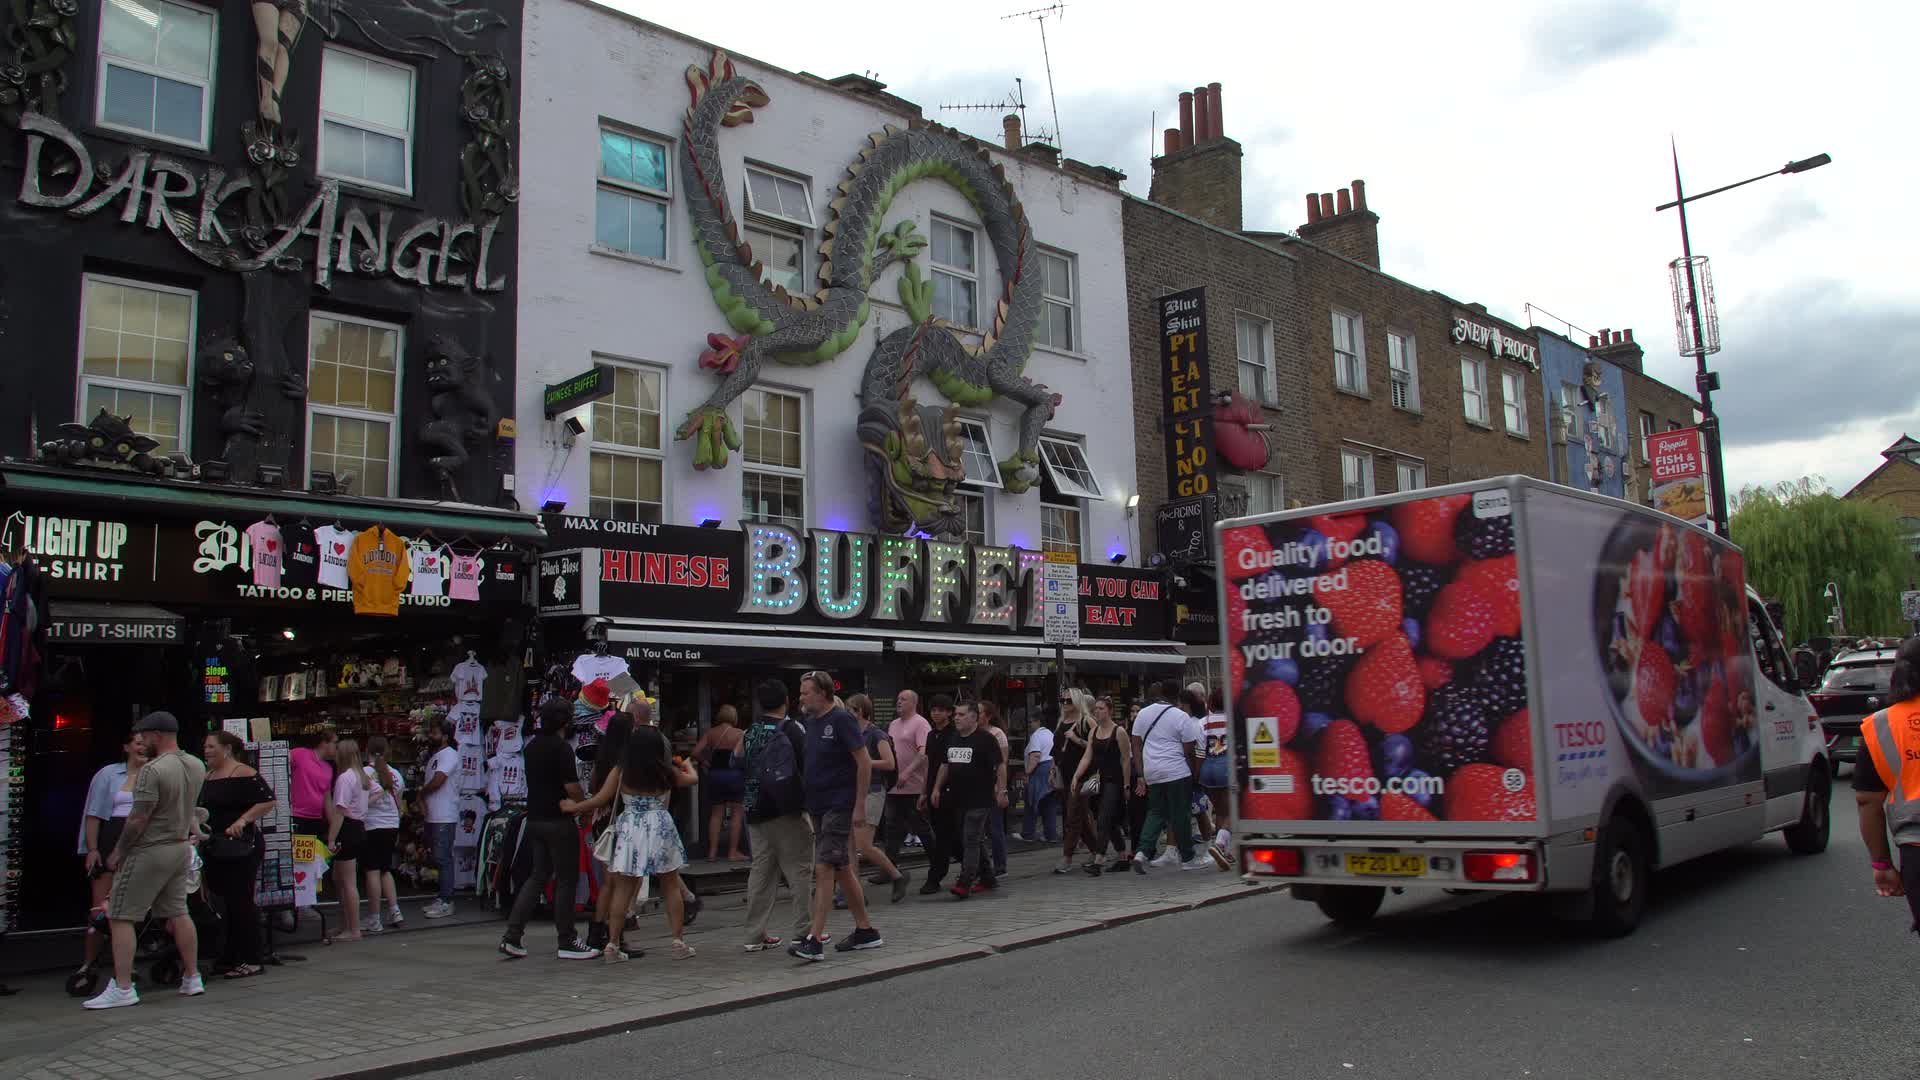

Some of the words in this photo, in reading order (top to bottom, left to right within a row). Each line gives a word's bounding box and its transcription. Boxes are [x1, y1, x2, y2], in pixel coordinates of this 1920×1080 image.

[18, 112, 255, 246] DARK
[261, 180, 506, 292] ANGEL
[1165, 298, 1199, 316] Blue
[1166, 315, 1201, 336] Skin
[1455, 318, 1491, 345] NEW
[1503, 336, 1539, 370] ROCK
[574, 373, 599, 394] BUFFET
[1185, 332, 1210, 494] TATTOO
[1655, 453, 1683, 466] FISH
[1686, 452, 1695, 462] &
[1656, 462, 1696, 476] CHIPS
[564, 517, 599, 531] MAX
[603, 520, 660, 536] ORIENT
[24, 515, 91, 558] LIGHT
[96, 521, 127, 560] UP
[324, 554, 348, 568] LONDON
[1238, 540, 1321, 570] Quality
[33, 559, 124, 582] -SHIRT
[418, 565, 439, 575] LONDON
[601, 548, 730, 591] HINESE
[1096, 577, 1128, 599] YOU
[1131, 579, 1160, 600] CAN
[1240, 567, 1349, 600] delivered
[237, 584, 302, 600] TATTOO
[305, 588, 317, 600] &
[322, 589, 353, 602] PIER
[400, 593, 451, 607] STUDIO
[1085, 605, 1137, 627] EAT
[1241, 605, 1300, 631] fresh
[1304, 604, 1332, 625] to
[69, 623, 94, 637] UP
[99, 623, 177, 639] T-SHIRTS
[626, 648, 640, 658] All
[643, 648, 661, 658] You
[664, 649, 683, 659] Can
[685, 650, 701, 659] Eat
[1240, 641, 1296, 668] your
[1300, 634, 1364, 657] door.
[206, 666, 229, 677] sleep.
[1552, 720, 1605, 748] TESCO
[1311, 774, 1444, 795] tesco.com
[295, 848, 313, 859] £18
[296, 840, 314, 848] EACH
